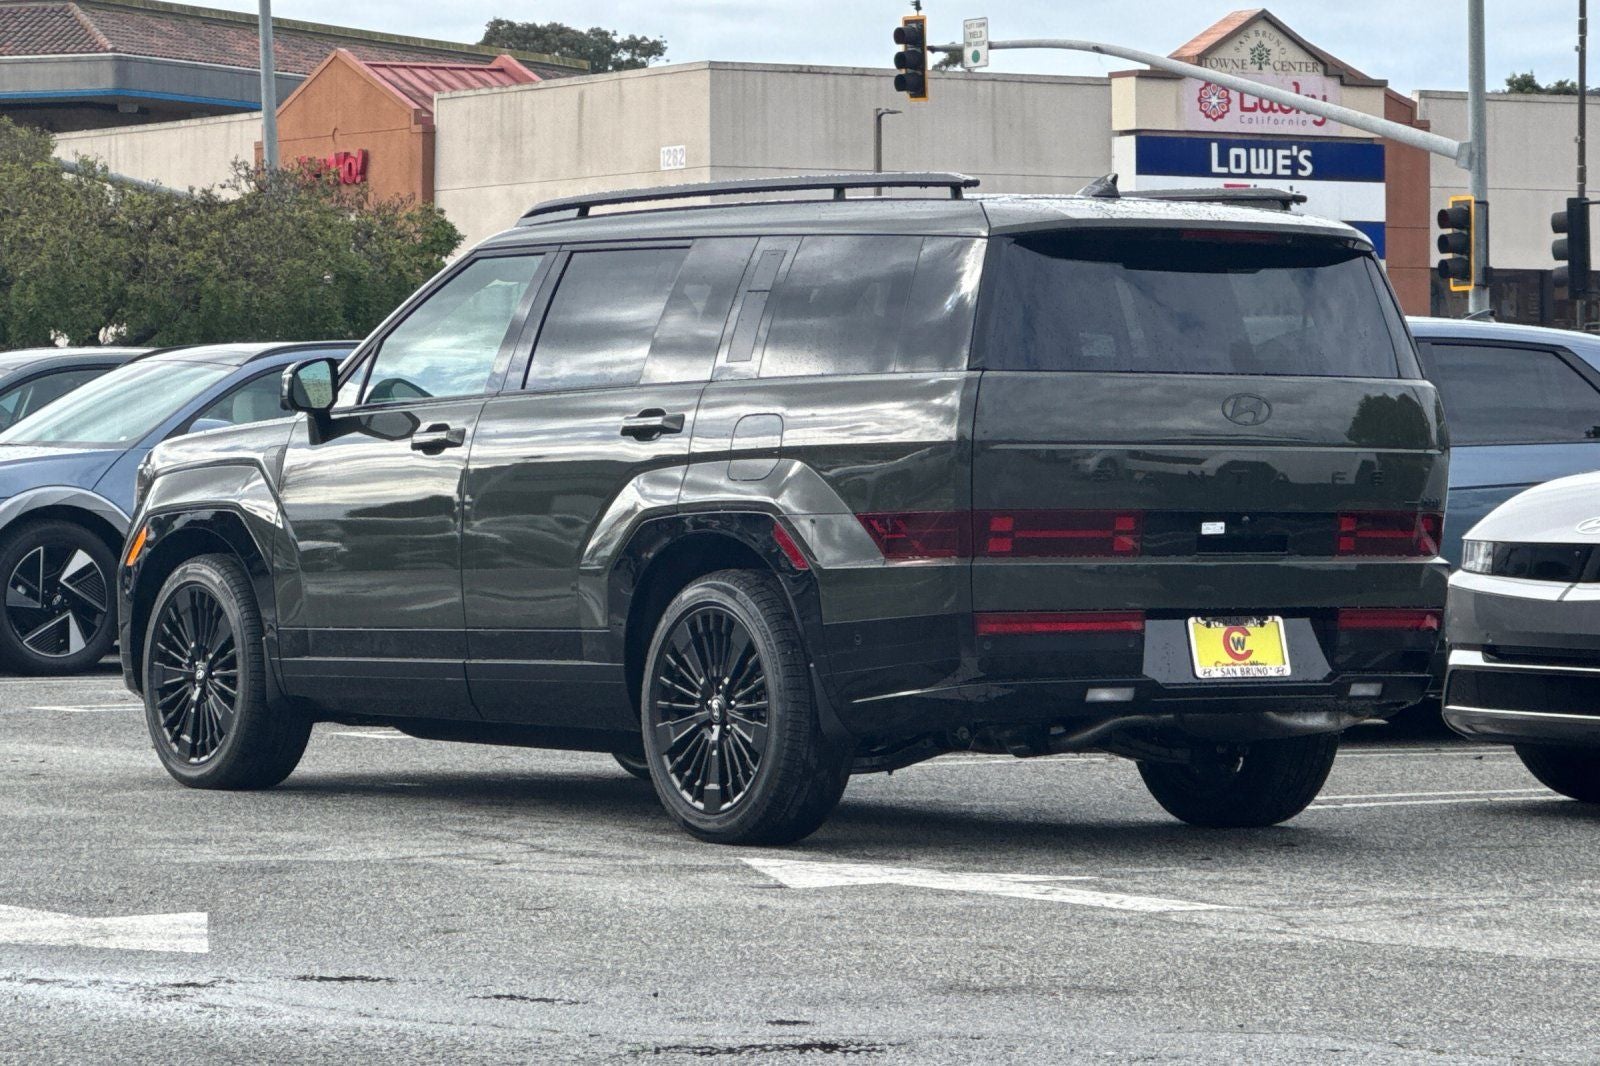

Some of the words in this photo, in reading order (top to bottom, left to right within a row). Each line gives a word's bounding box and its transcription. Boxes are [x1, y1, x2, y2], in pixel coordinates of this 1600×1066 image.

[1234, 34, 1251, 53] SAN
[1254, 29, 1287, 55] BRUNO
[1204, 57, 1248, 69] TOWNE
[1272, 61, 1319, 73] CENTER
[1239, 114, 1307, 127] California
[662, 148, 685, 167] 1282
[1210, 142, 1313, 176] LOWE'S
